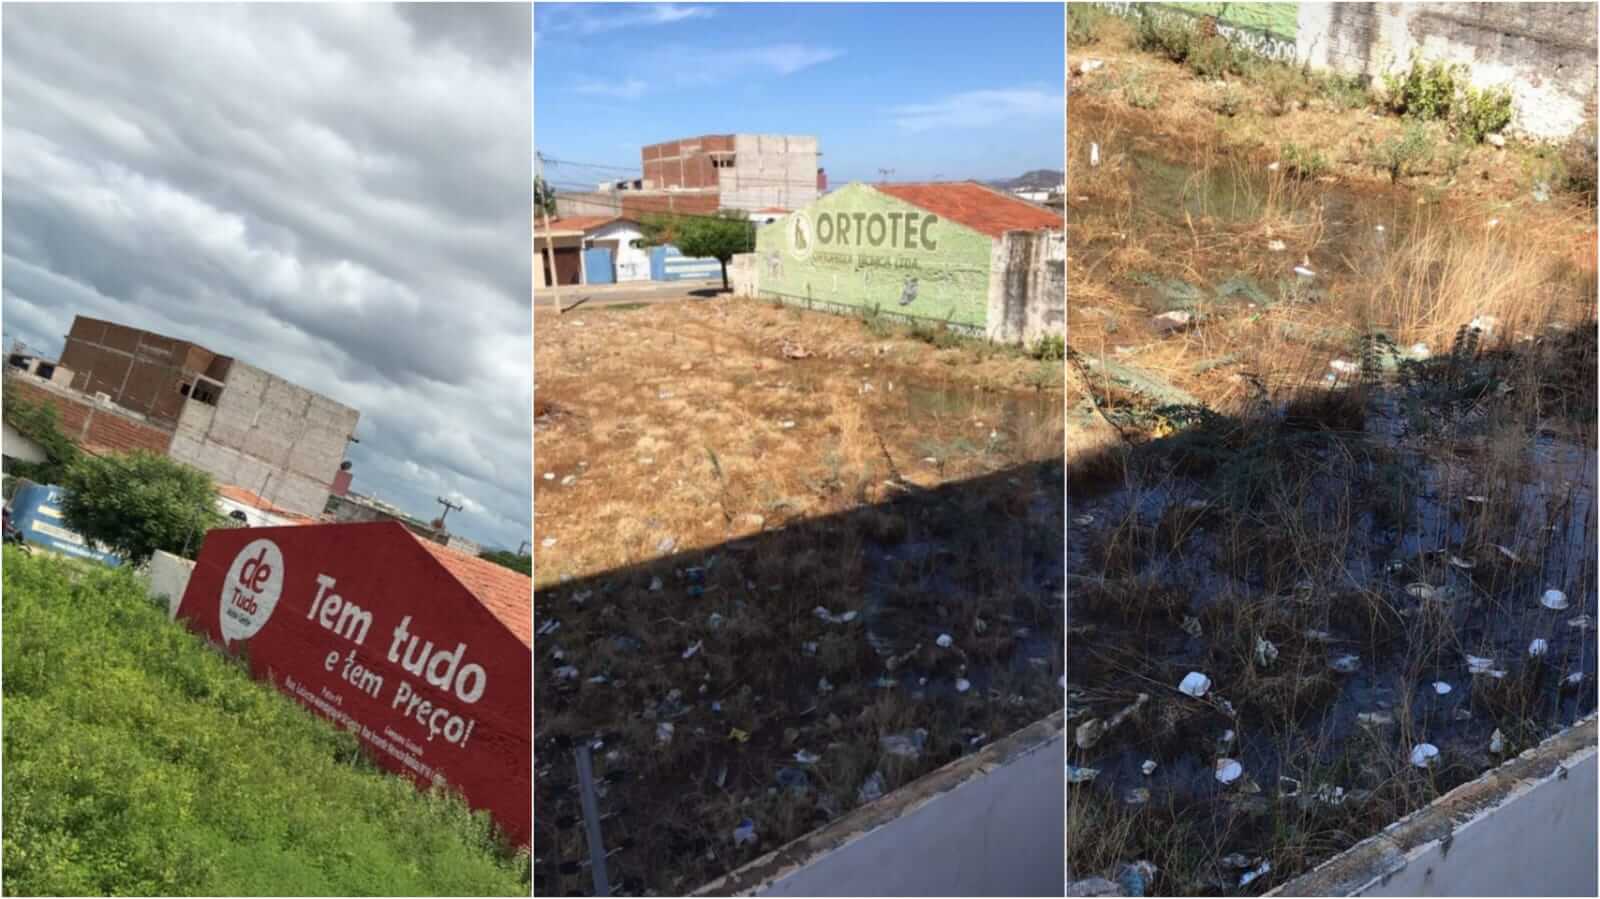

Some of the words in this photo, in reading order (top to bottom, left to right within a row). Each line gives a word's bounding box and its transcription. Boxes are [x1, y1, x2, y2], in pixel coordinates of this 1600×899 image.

[816, 212, 939, 251] ORTOTEC
[239, 547, 271, 594] de
[231, 587, 258, 615] Tudo
[307, 573, 373, 646] Tem
[387, 615, 487, 704] tudo
[324, 650, 340, 672] e
[342, 649, 384, 698] tem
[392, 680, 476, 749] Preço!
